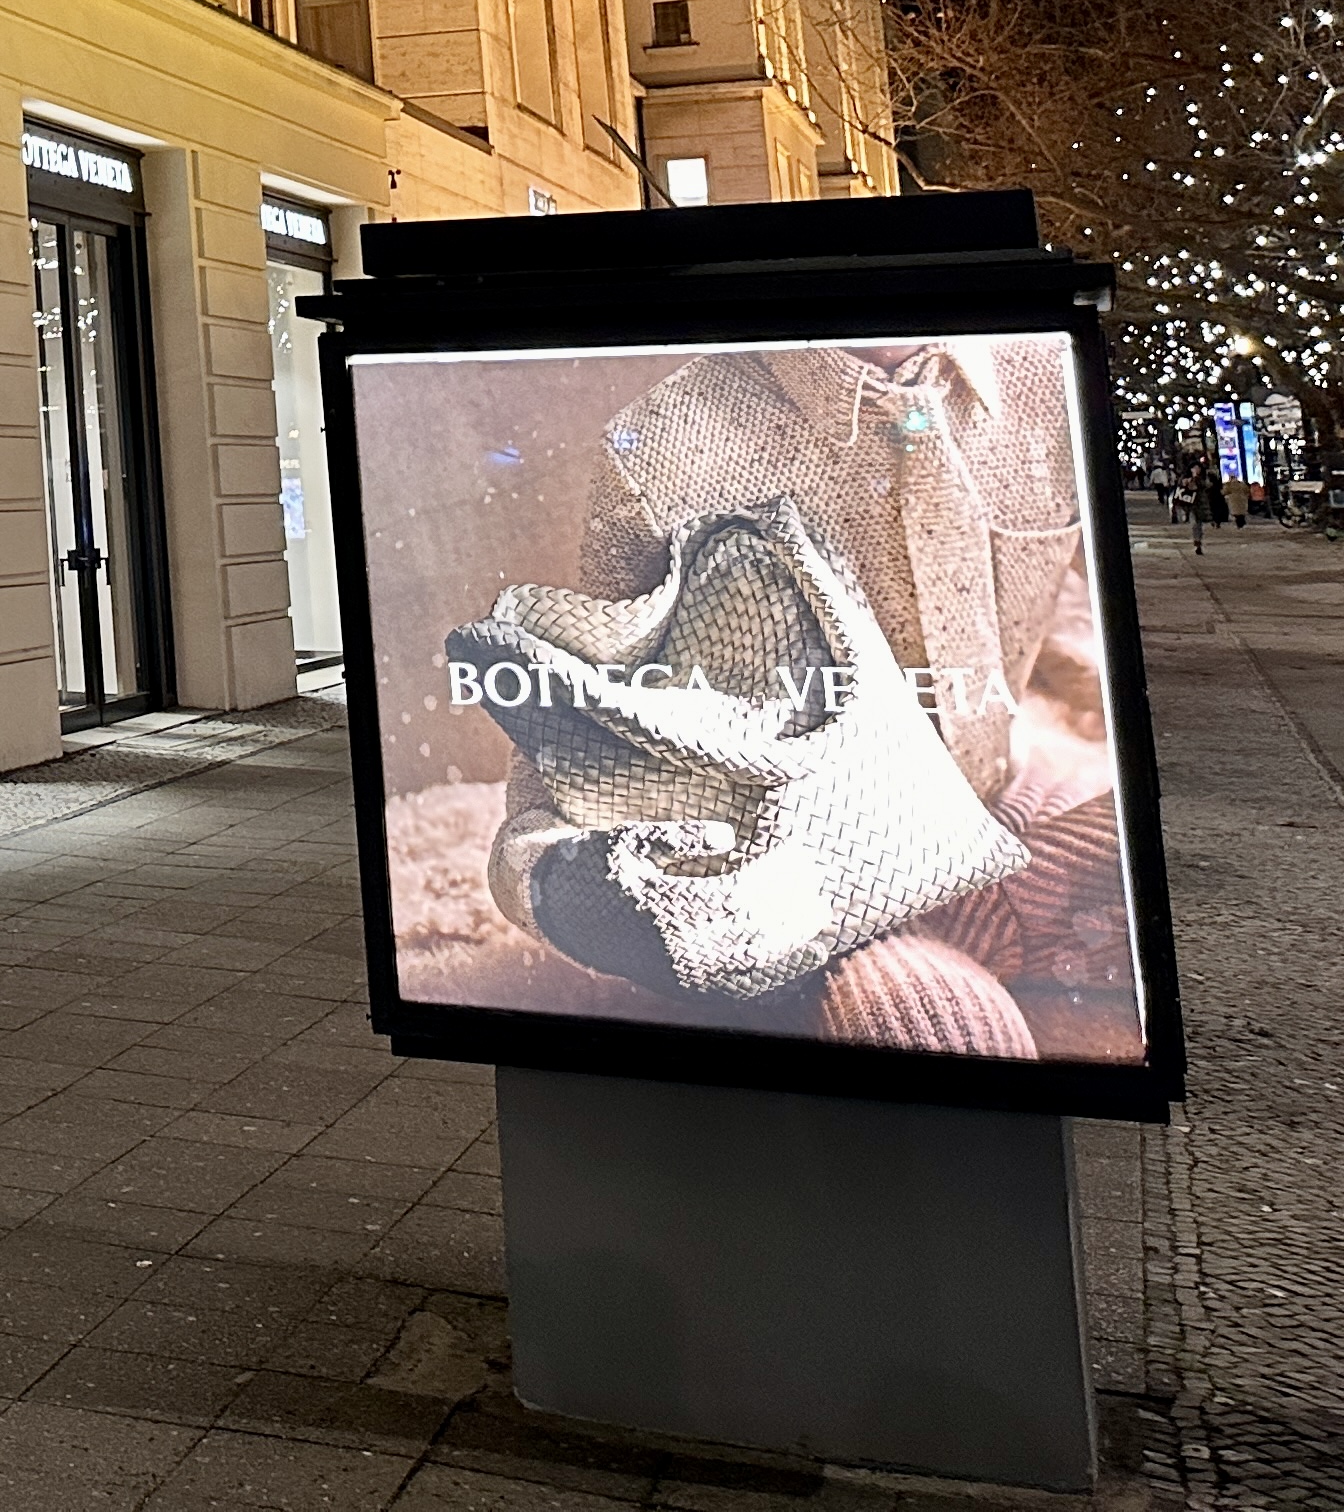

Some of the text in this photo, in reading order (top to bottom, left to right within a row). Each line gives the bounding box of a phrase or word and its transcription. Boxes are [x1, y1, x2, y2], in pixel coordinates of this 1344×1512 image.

[21, 133, 133, 193] OTTEGA VENETA
[775, 666, 1021, 716] VEETA
